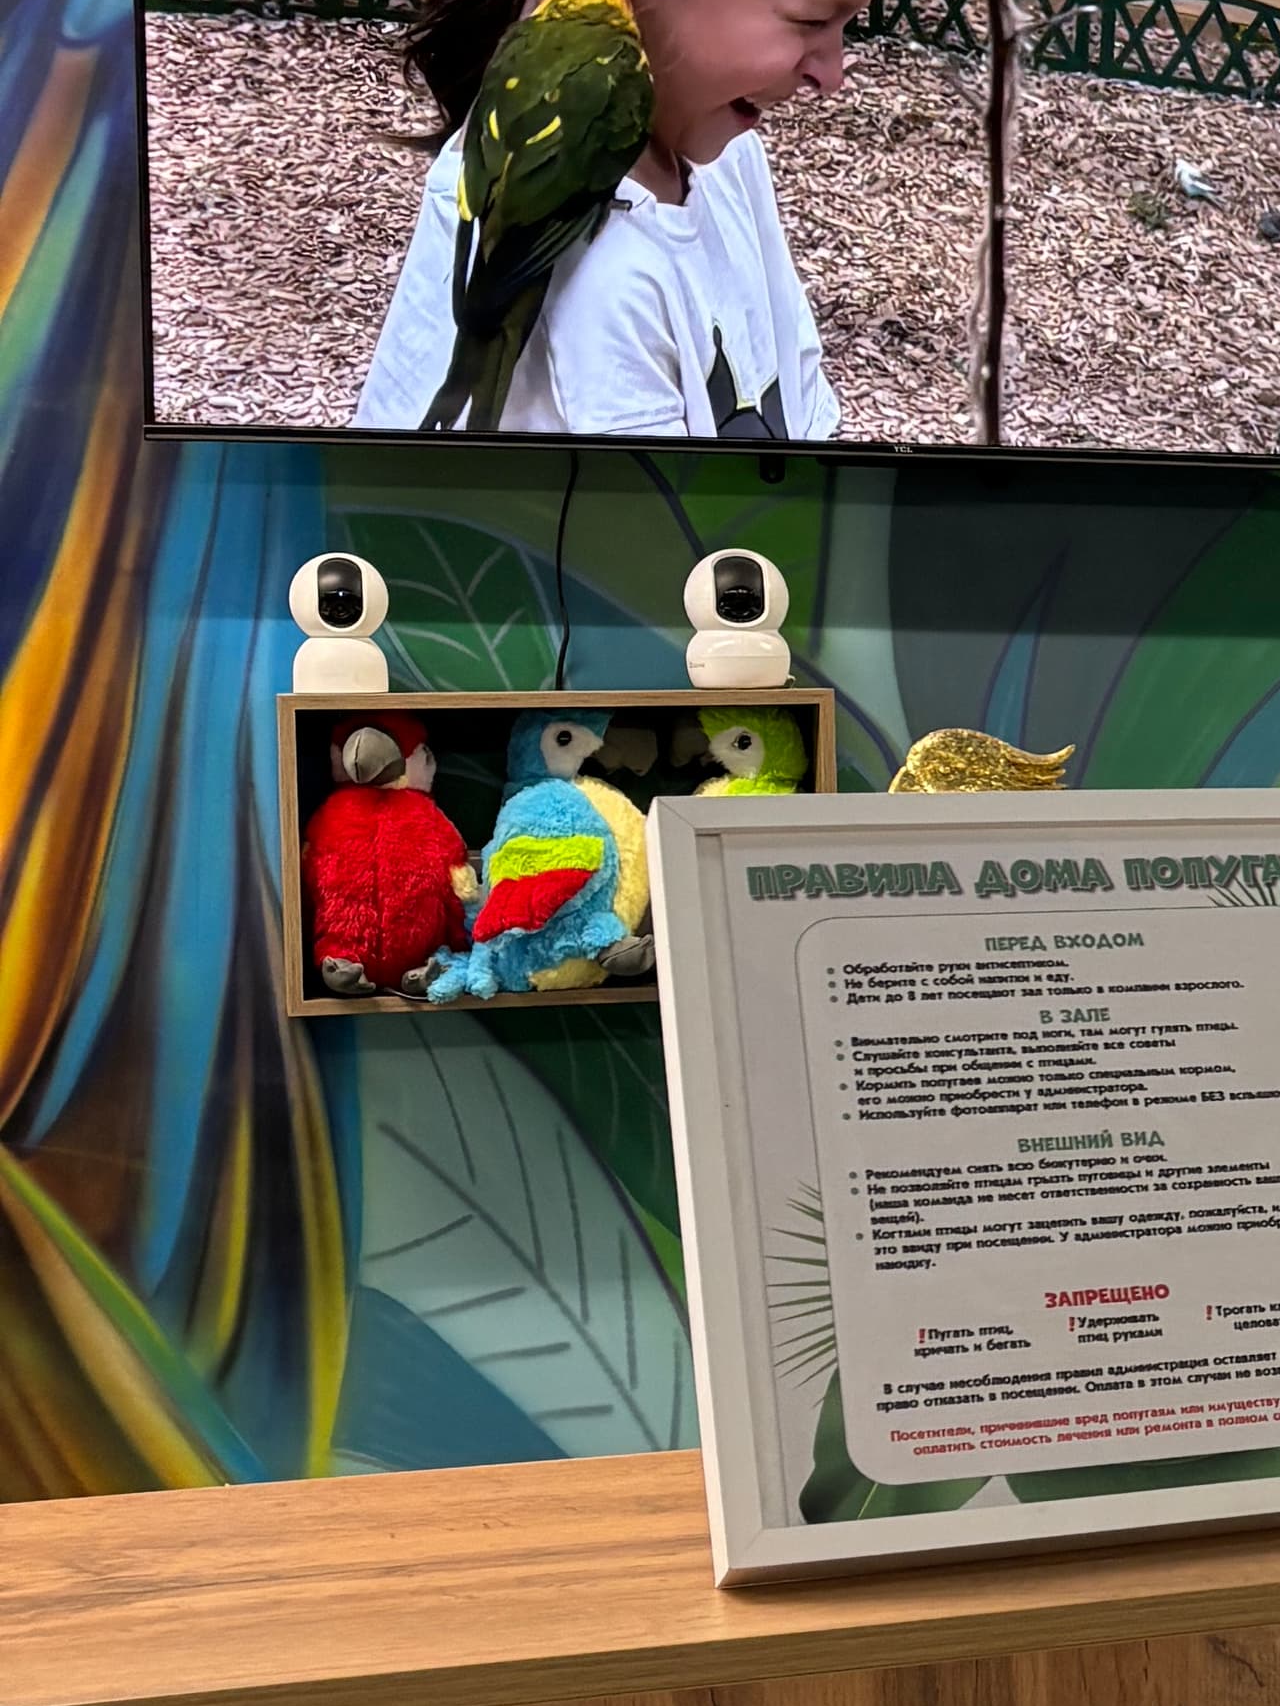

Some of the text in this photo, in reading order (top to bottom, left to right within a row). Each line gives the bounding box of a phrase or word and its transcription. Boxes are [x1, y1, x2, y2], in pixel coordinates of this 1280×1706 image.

[746, 861, 960, 900] ПРАВИЛА
[974, 857, 1114, 896] ДОМА
[984, 932, 1144, 953] ПЕРЕД ВХОДОМ
[1039, 1006, 1110, 1025] В ЗАЛЕ
[1017, 1131, 1165, 1152] ВНЕШНИЙ ВИД
[1044, 1284, 1169, 1308] ЗАПРЕЩЕНО
